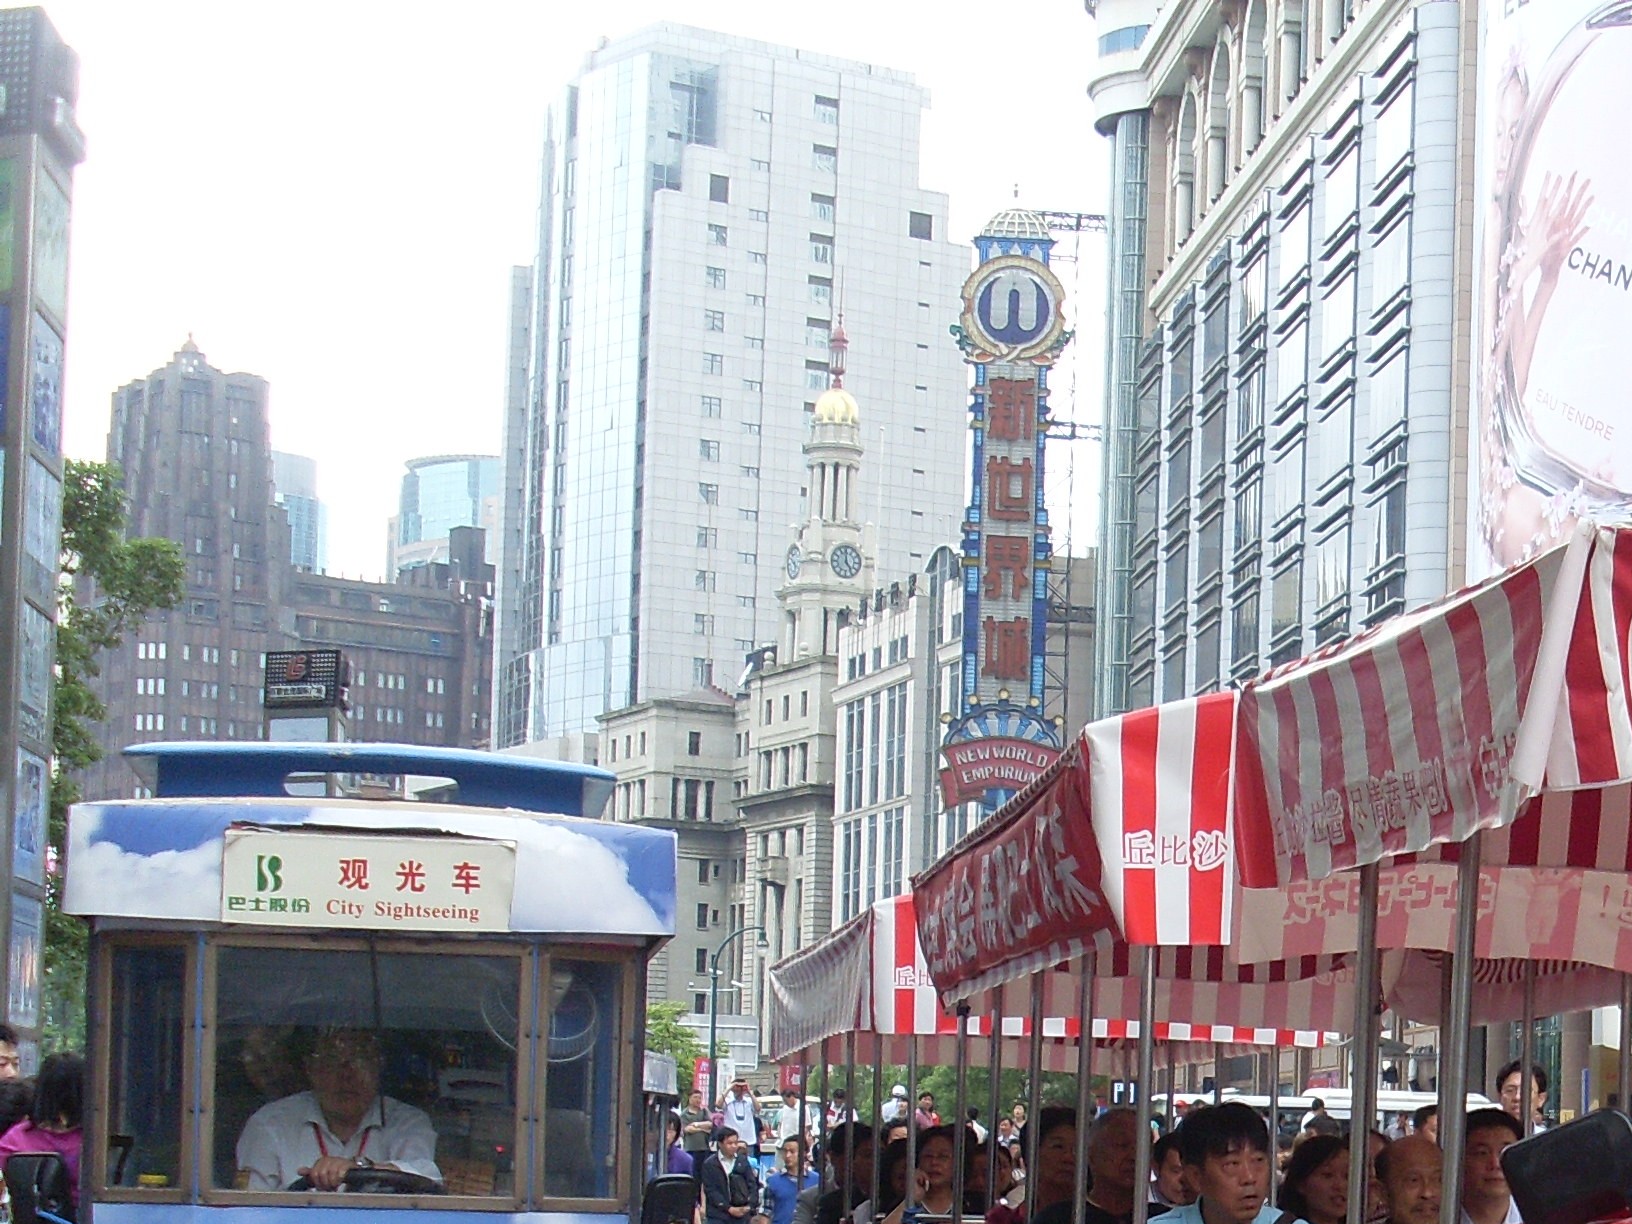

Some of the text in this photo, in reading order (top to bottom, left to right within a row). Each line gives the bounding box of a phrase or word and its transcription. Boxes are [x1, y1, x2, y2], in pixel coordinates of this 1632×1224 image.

[1536, 388, 1615, 441] EAU TENDRE
[982, 377, 1034, 682] 新世界城
[955, 746, 1048, 768] NEW WORLD
[961, 765, 1043, 785] EMPORIUM
[1123, 830, 1234, 871] 丘比沙
[339, 858, 481, 895] 观光车
[227, 896, 311, 914] 巴士股份
[326, 899, 481, 922] City Sightseeing
[895, 966, 937, 987] 丘比
